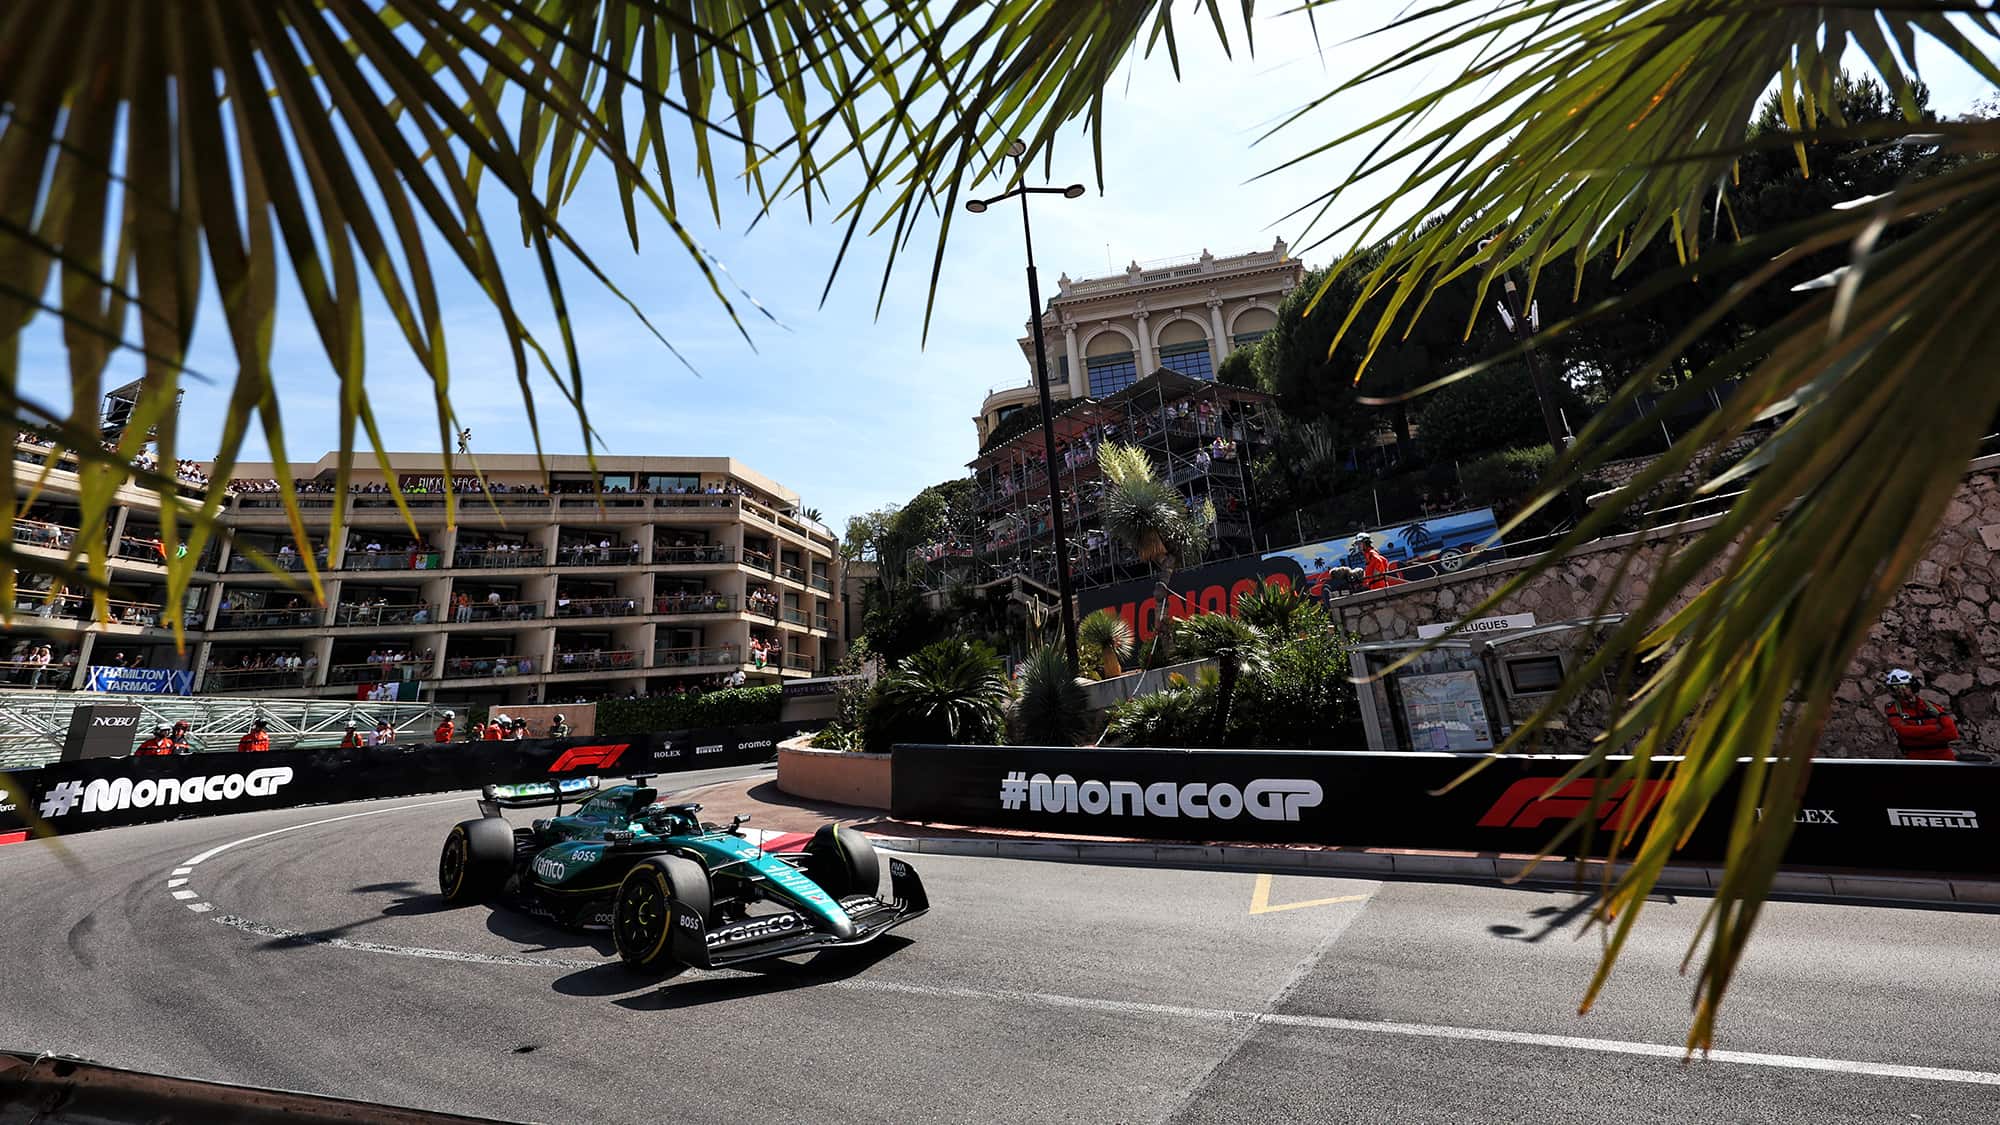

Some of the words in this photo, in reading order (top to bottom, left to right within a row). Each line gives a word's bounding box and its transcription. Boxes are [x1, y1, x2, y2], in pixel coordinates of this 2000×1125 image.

[102, 666, 165, 680] HAMILTON
[105, 680, 156, 692] TARMAC
[92, 716, 136, 727] NOBU
[738, 740, 772, 750] aramco
[654, 750, 681, 758] ROLEX
[1886, 808, 1979, 828] PIRELLI
[571, 850, 597, 862] BOSS
[679, 914, 699, 930] BOSS
[705, 914, 795, 946] aramco
